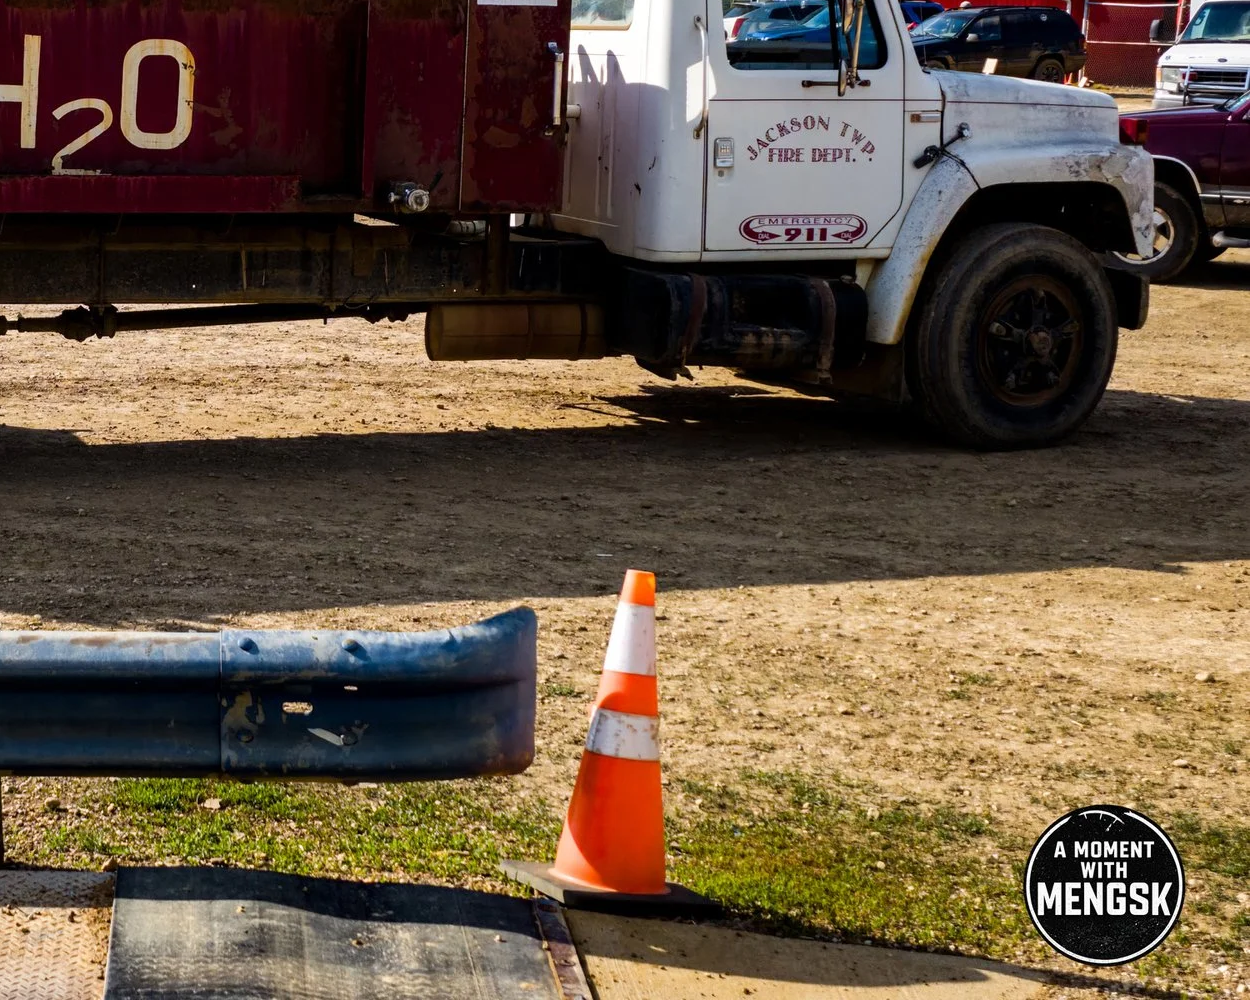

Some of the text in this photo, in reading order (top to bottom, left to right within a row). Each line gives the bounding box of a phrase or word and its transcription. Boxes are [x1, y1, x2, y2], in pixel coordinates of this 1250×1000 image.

[747, 115, 831, 161] JACKSON
[768, 147, 857, 162] FIRE DEPT.
[758, 217, 853, 225] EMERGENCY
